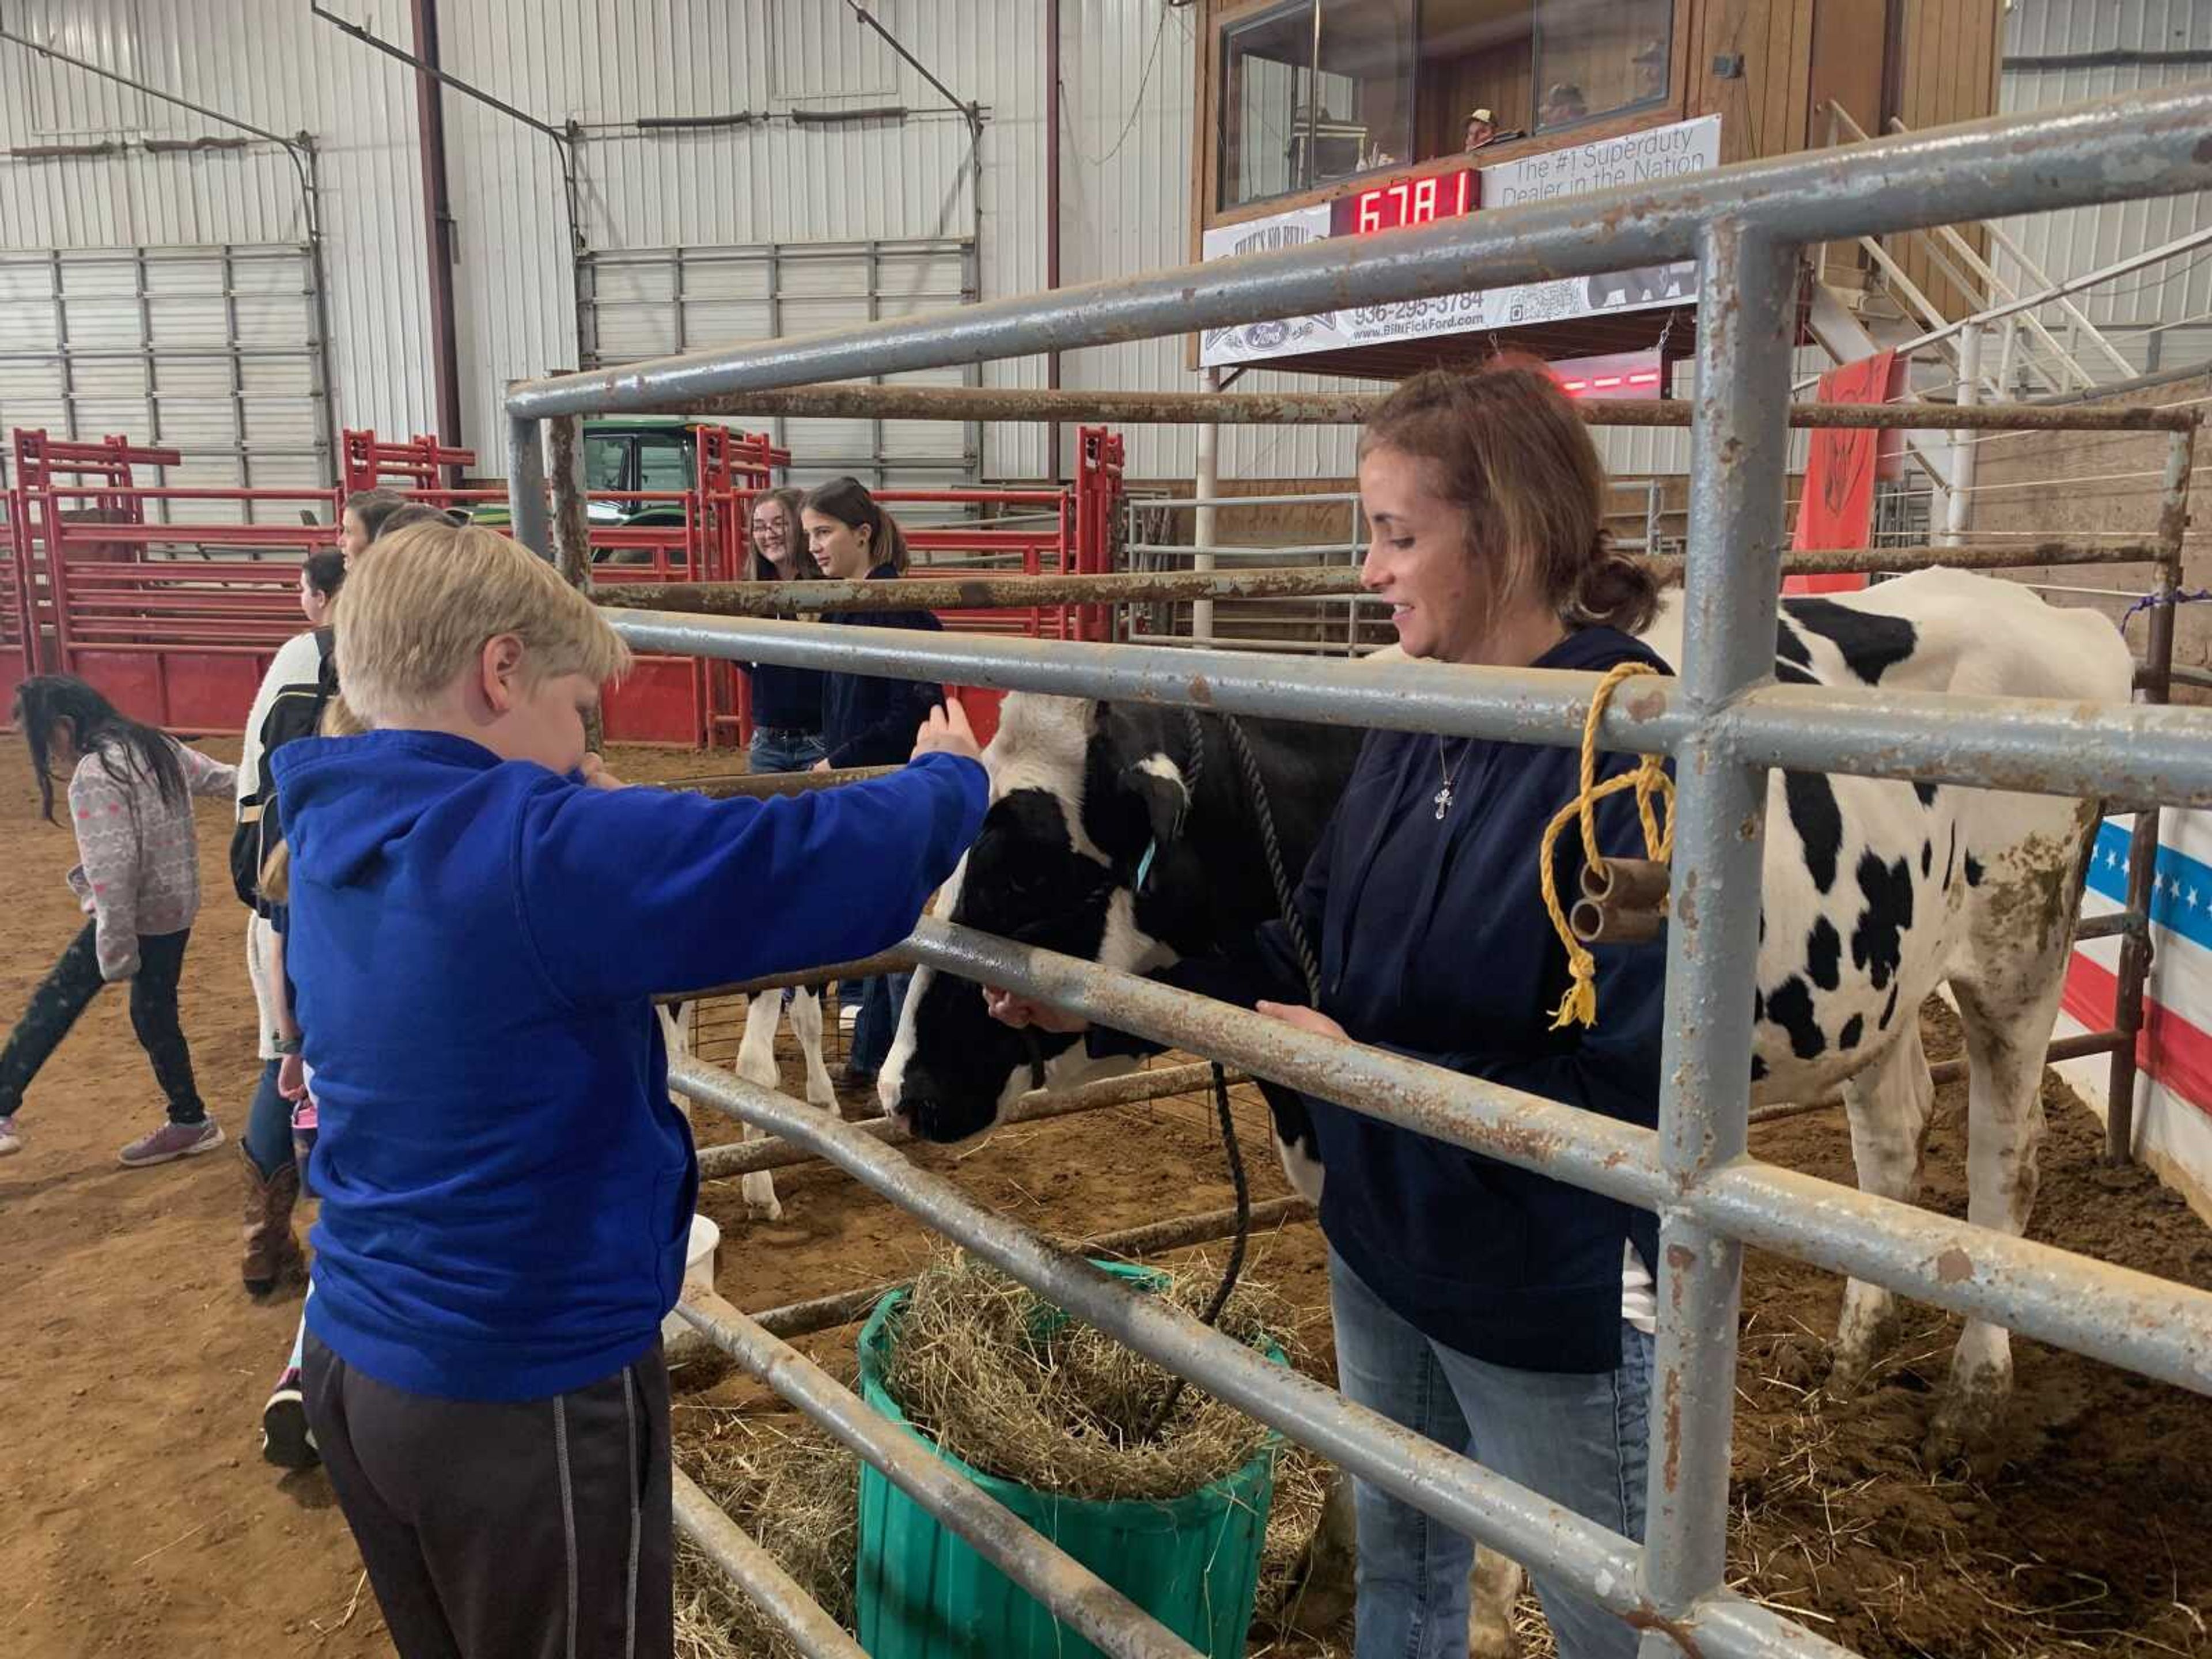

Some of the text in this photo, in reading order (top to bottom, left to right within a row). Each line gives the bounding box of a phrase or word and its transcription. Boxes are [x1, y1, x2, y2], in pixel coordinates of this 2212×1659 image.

[1502, 151, 1705, 206] Dealer in the Nation
[1516, 128, 1693, 181] The #1 Superduty
[1355, 291, 1483, 325] 936-295-3784
